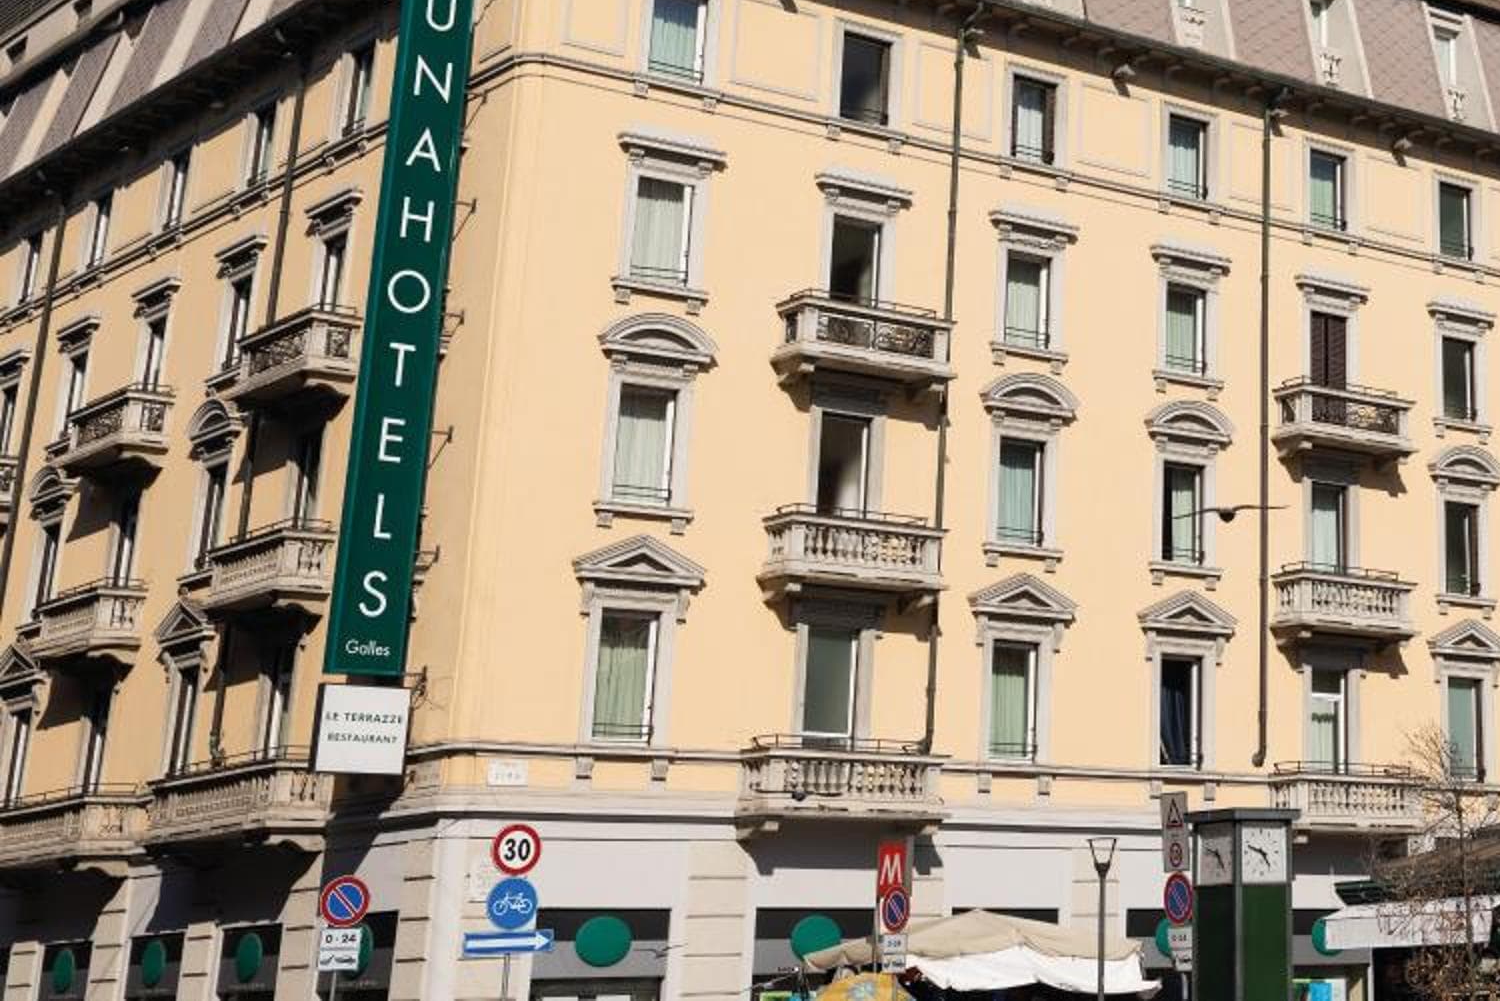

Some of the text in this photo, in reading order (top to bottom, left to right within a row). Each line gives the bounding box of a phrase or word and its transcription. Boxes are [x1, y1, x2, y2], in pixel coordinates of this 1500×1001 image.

[345, 639, 391, 657] Galles
[326, 711, 402, 724] LE TERRAZZE
[327, 732, 398, 744] RESTAURANT
[503, 838, 532, 862] 30
[879, 853, 903, 886] M
